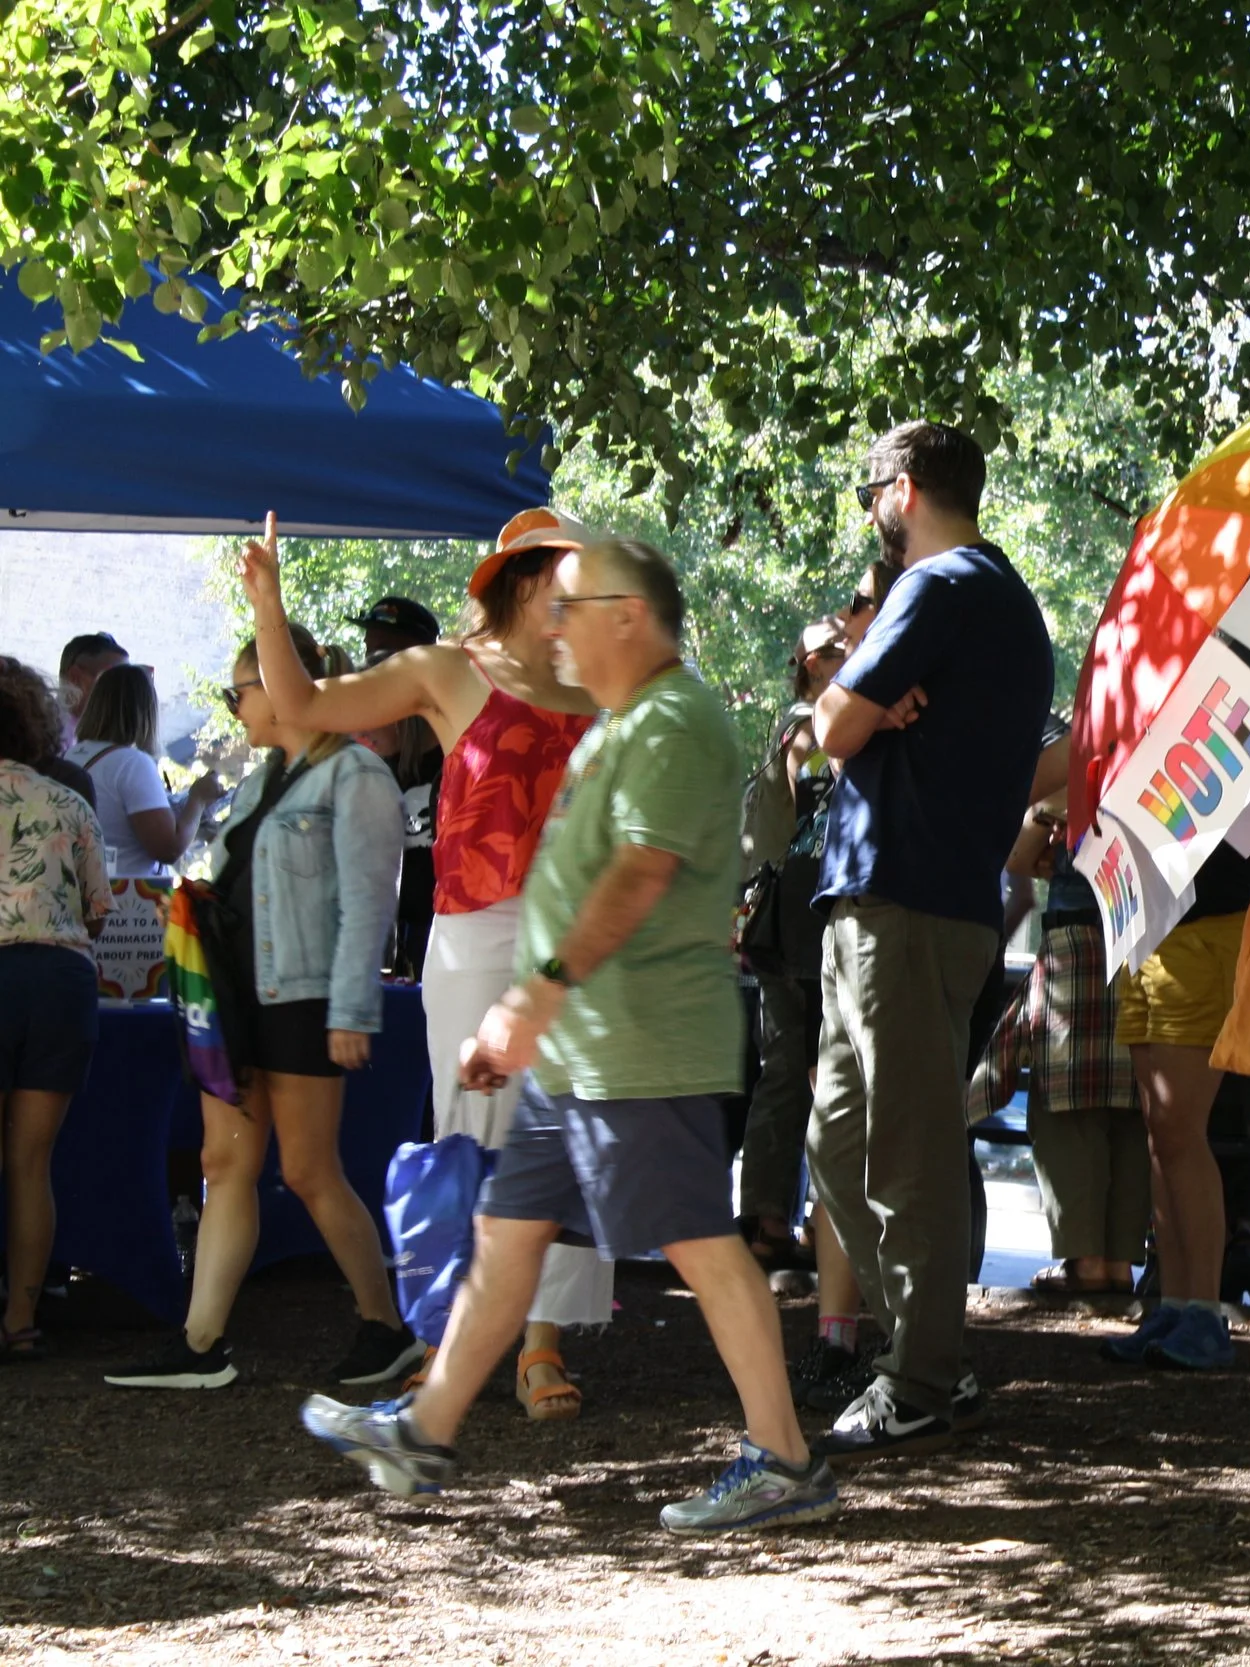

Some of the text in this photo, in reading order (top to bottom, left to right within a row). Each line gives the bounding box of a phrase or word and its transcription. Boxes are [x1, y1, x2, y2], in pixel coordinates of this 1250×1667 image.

[1094, 836, 1138, 945] VOTE
[133, 918, 147, 927] TO
[151, 918, 159, 927] A
[95, 934, 163, 944] PHARMACIST
[96, 951, 133, 960] ABOUT
